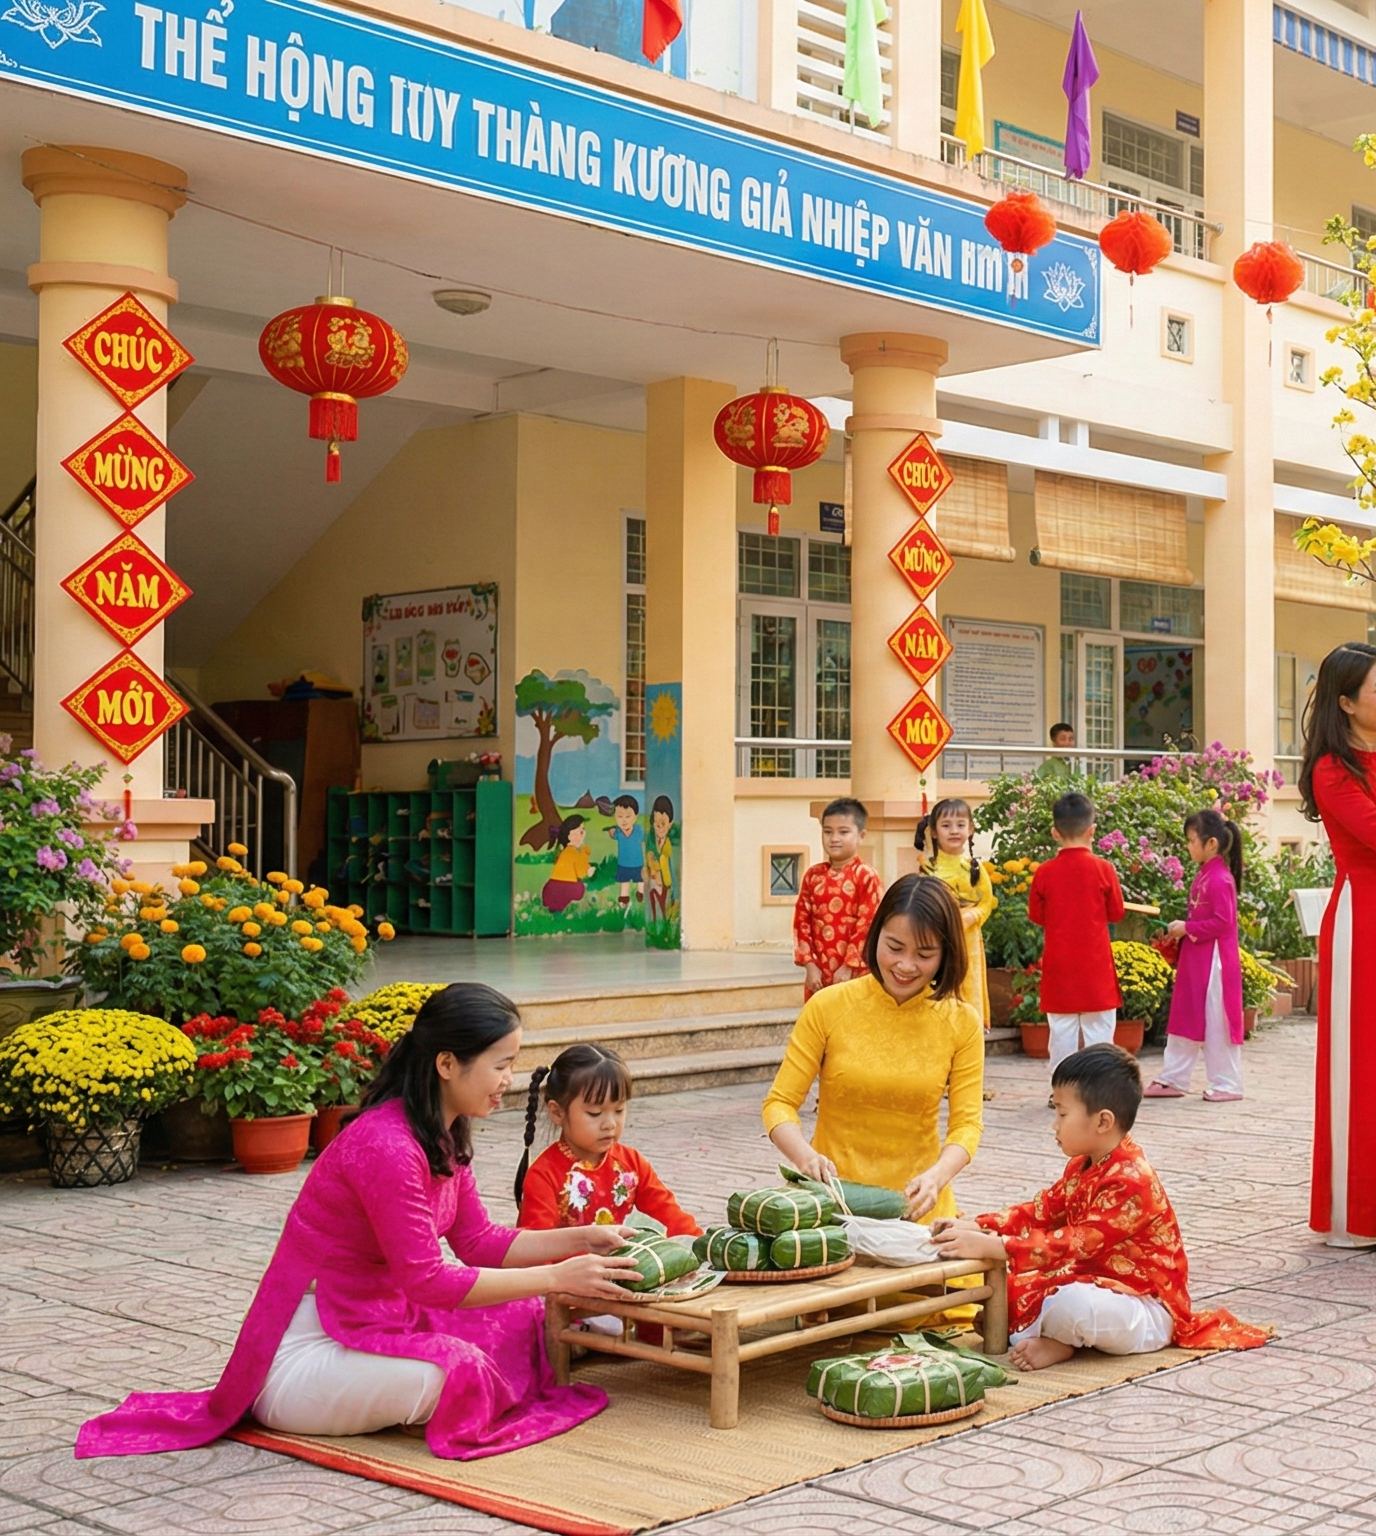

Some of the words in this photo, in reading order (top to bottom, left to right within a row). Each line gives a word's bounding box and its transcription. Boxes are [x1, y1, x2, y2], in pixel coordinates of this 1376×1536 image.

[134, 0, 234, 90] THỂ
[246, 32, 375, 128] HỘNG
[472, 100, 601, 187] THÀNG
[613, 138, 731, 222] KƯƠNG
[741, 168, 794, 238] GIẢ
[801, 192, 890, 268] NHIỆP
[897, 215, 952, 280] VĂN
[94, 326, 163, 374] CHÚC
[94, 443, 165, 492] MỪNG
[903, 456, 940, 490] CHÚC
[95, 561, 160, 609] NĂM
[904, 627, 939, 660] NĂM
[97, 680, 155, 726] MỚI
